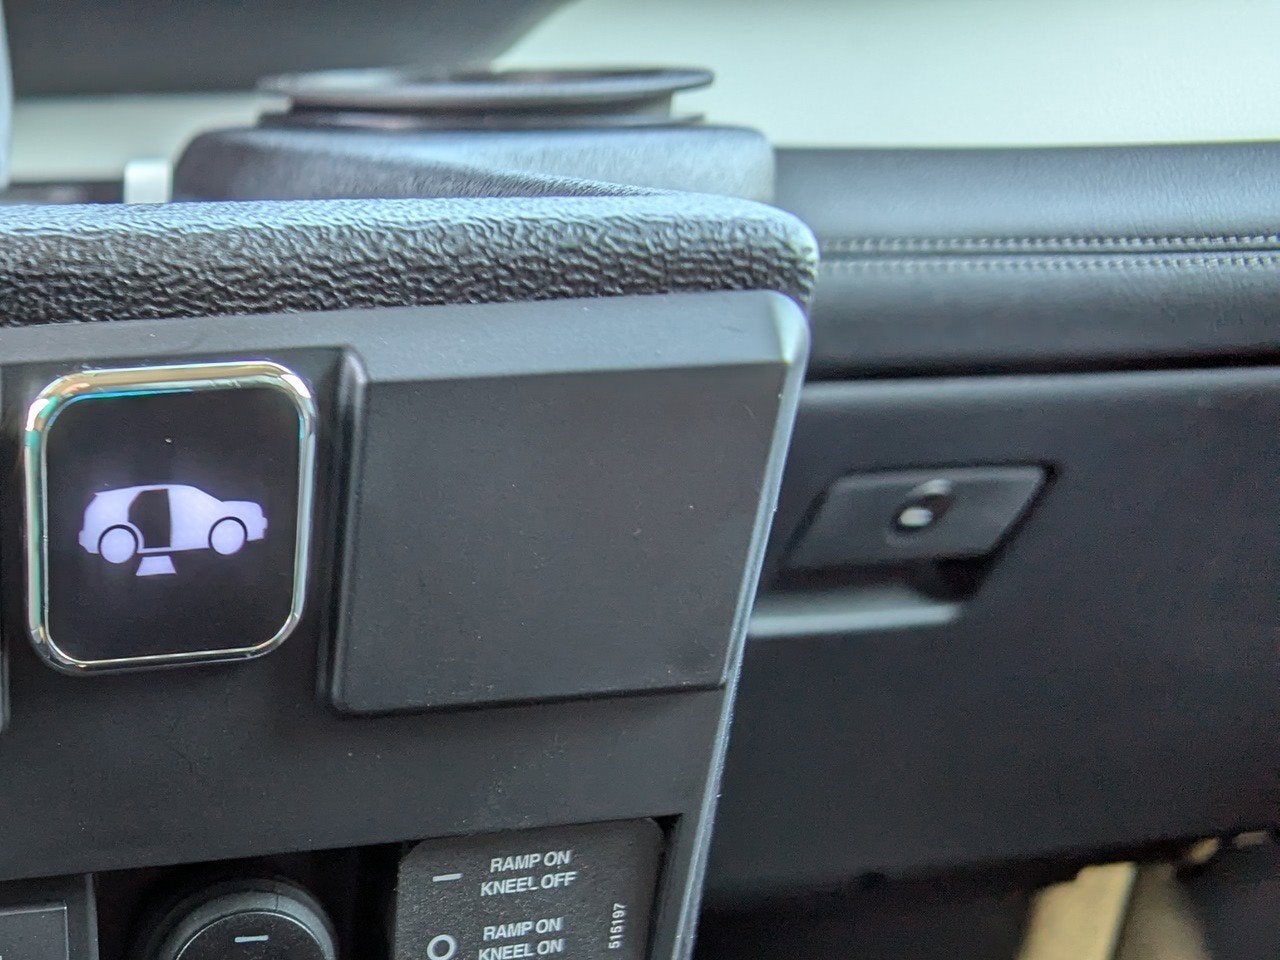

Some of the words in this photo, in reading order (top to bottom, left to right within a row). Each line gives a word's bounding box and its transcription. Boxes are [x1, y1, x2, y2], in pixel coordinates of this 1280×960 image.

[490, 853, 540, 872] RAMP
[543, 850, 571, 866] ON
[480, 876, 538, 896] KNEEL
[540, 871, 577, 888] OFF
[483, 921, 533, 941] RAMP
[535, 917, 563, 933] ON
[608, 902, 627, 949] 515197
[537, 939, 564, 955] ON
